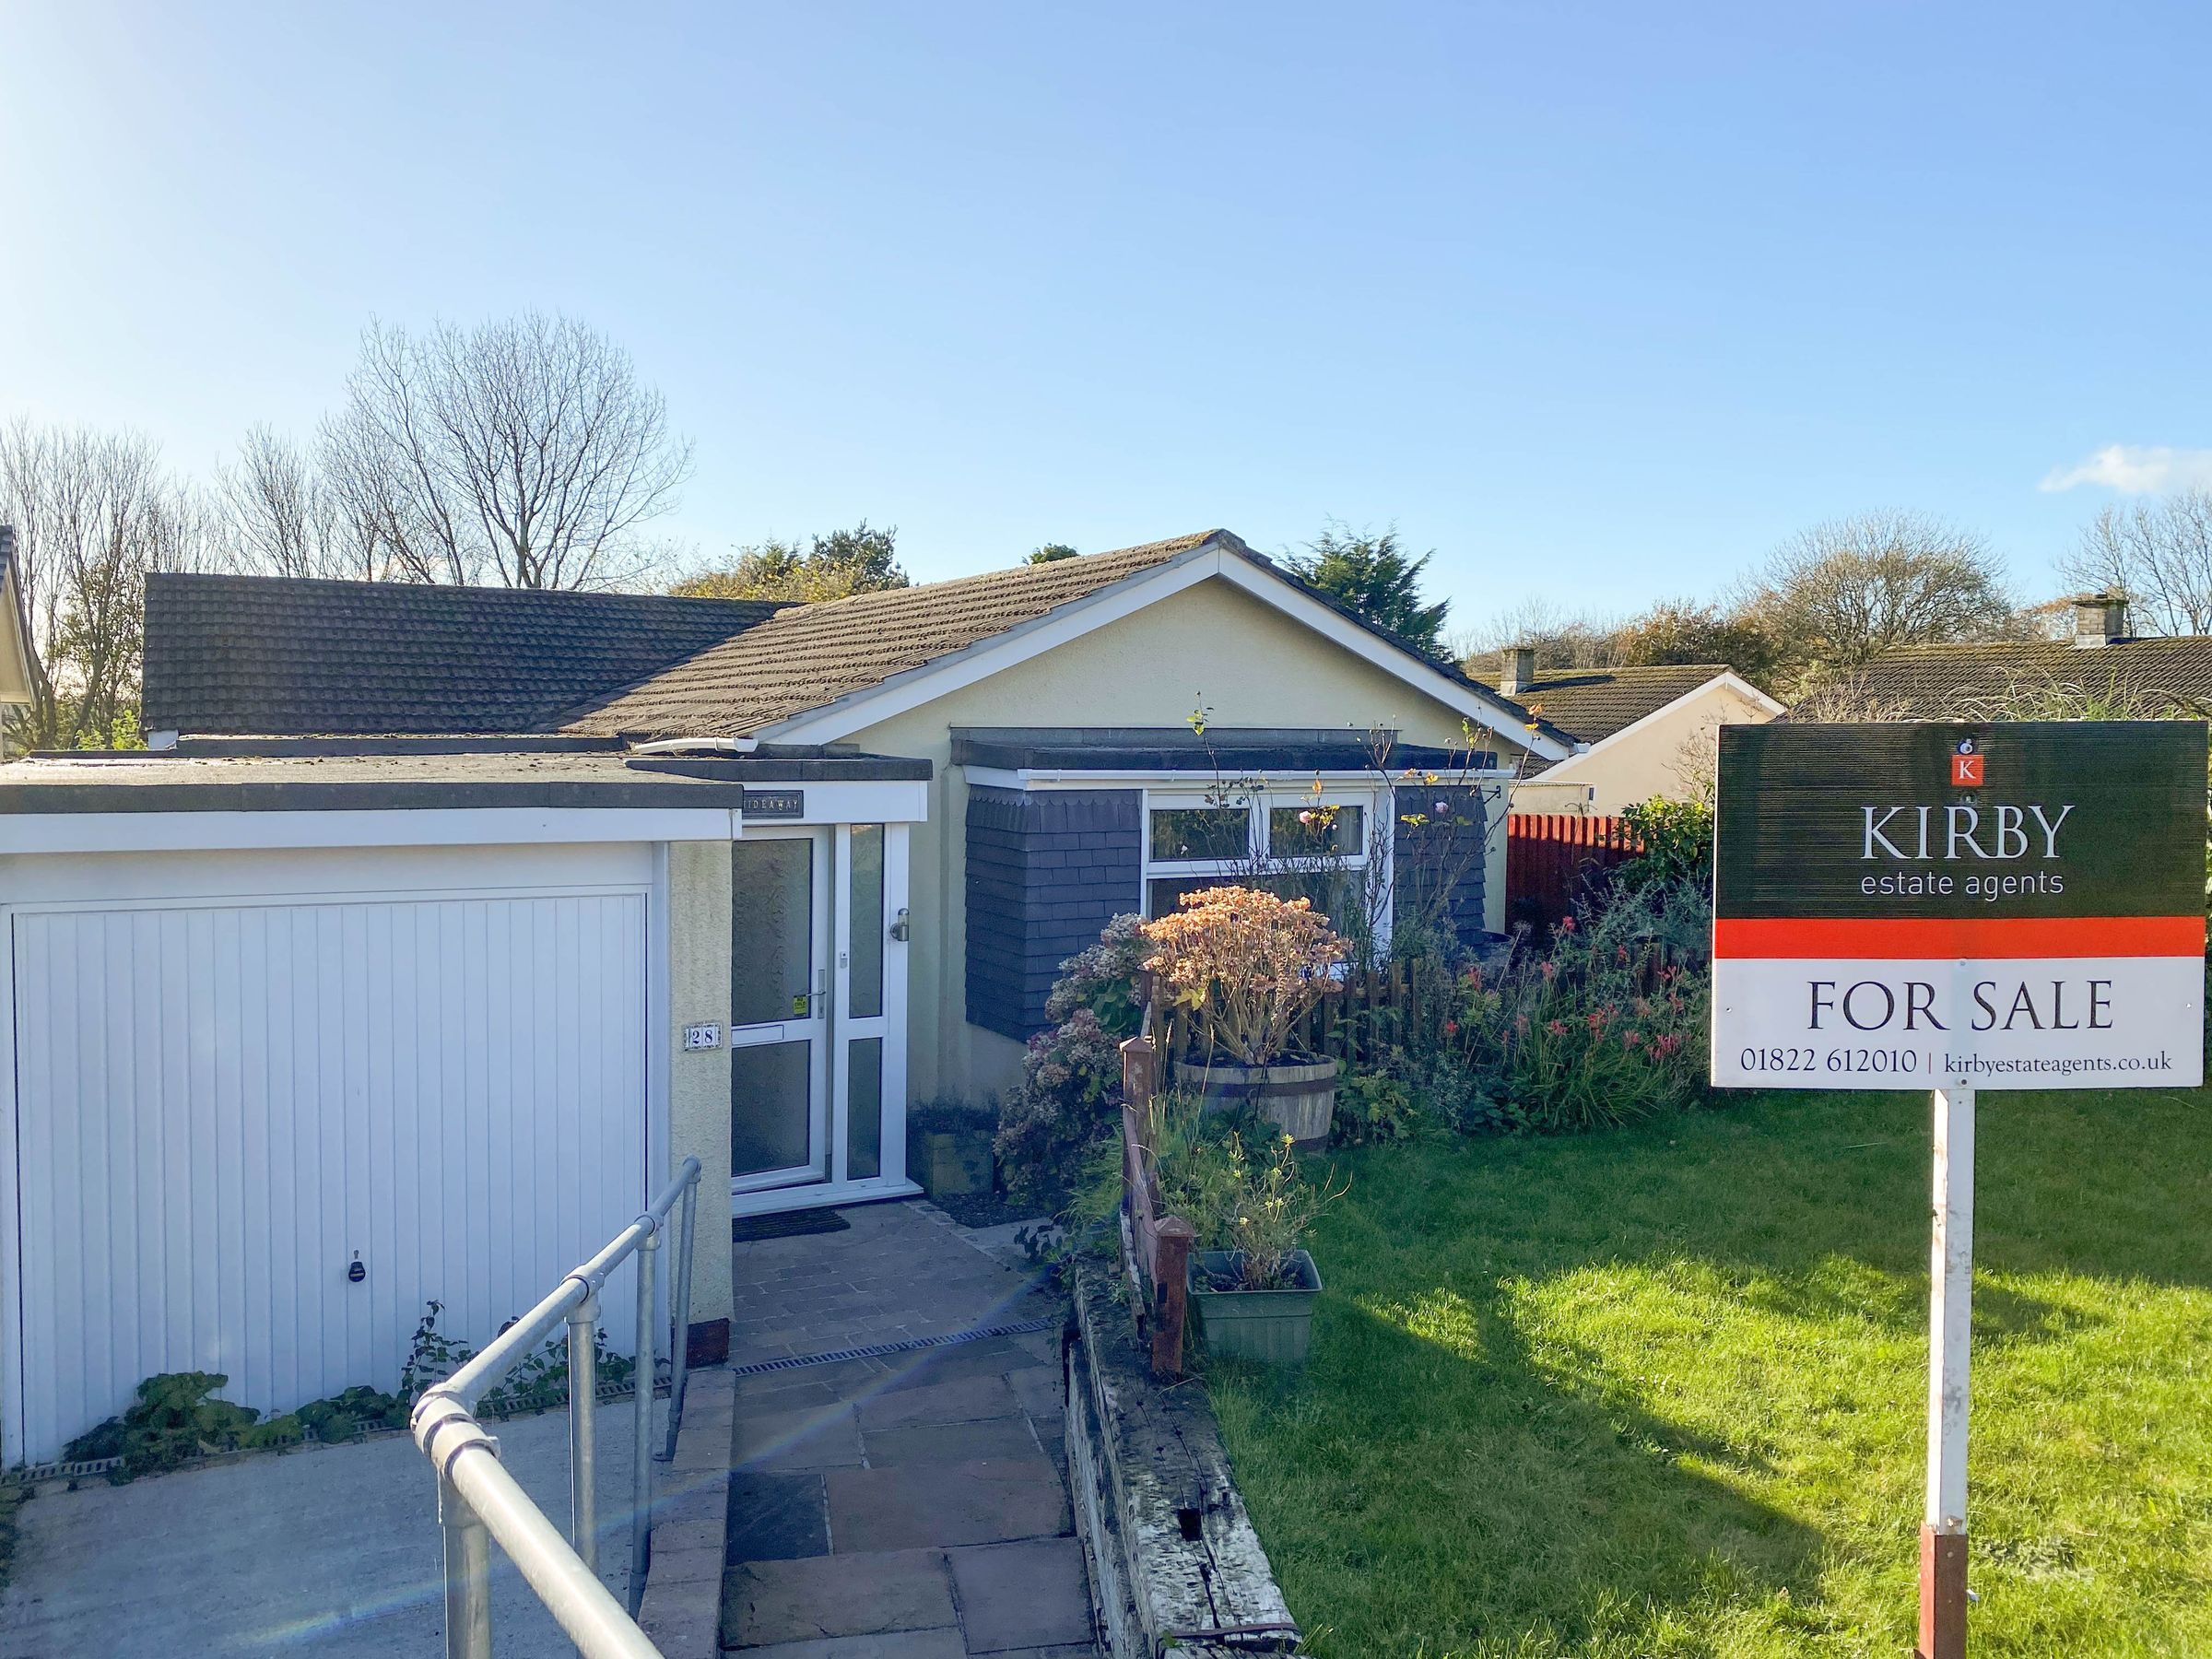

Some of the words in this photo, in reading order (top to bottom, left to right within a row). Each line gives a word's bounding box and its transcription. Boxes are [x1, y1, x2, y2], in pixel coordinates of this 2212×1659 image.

[1959, 760, 1975, 780] K
[1860, 806, 2076, 860] KIRBY
[1861, 872, 1954, 896] estate
[1965, 870, 2065, 901] agents
[1806, 982, 1950, 1031] FOR
[1971, 981, 2114, 1030] SALE
[692, 1030, 713, 1044] 28
[1740, 1048, 1817, 1072] 01822
[1827, 1049, 1918, 1073] 612010
[1944, 1051, 2173, 1077] kirbyestateagents.co.uk
